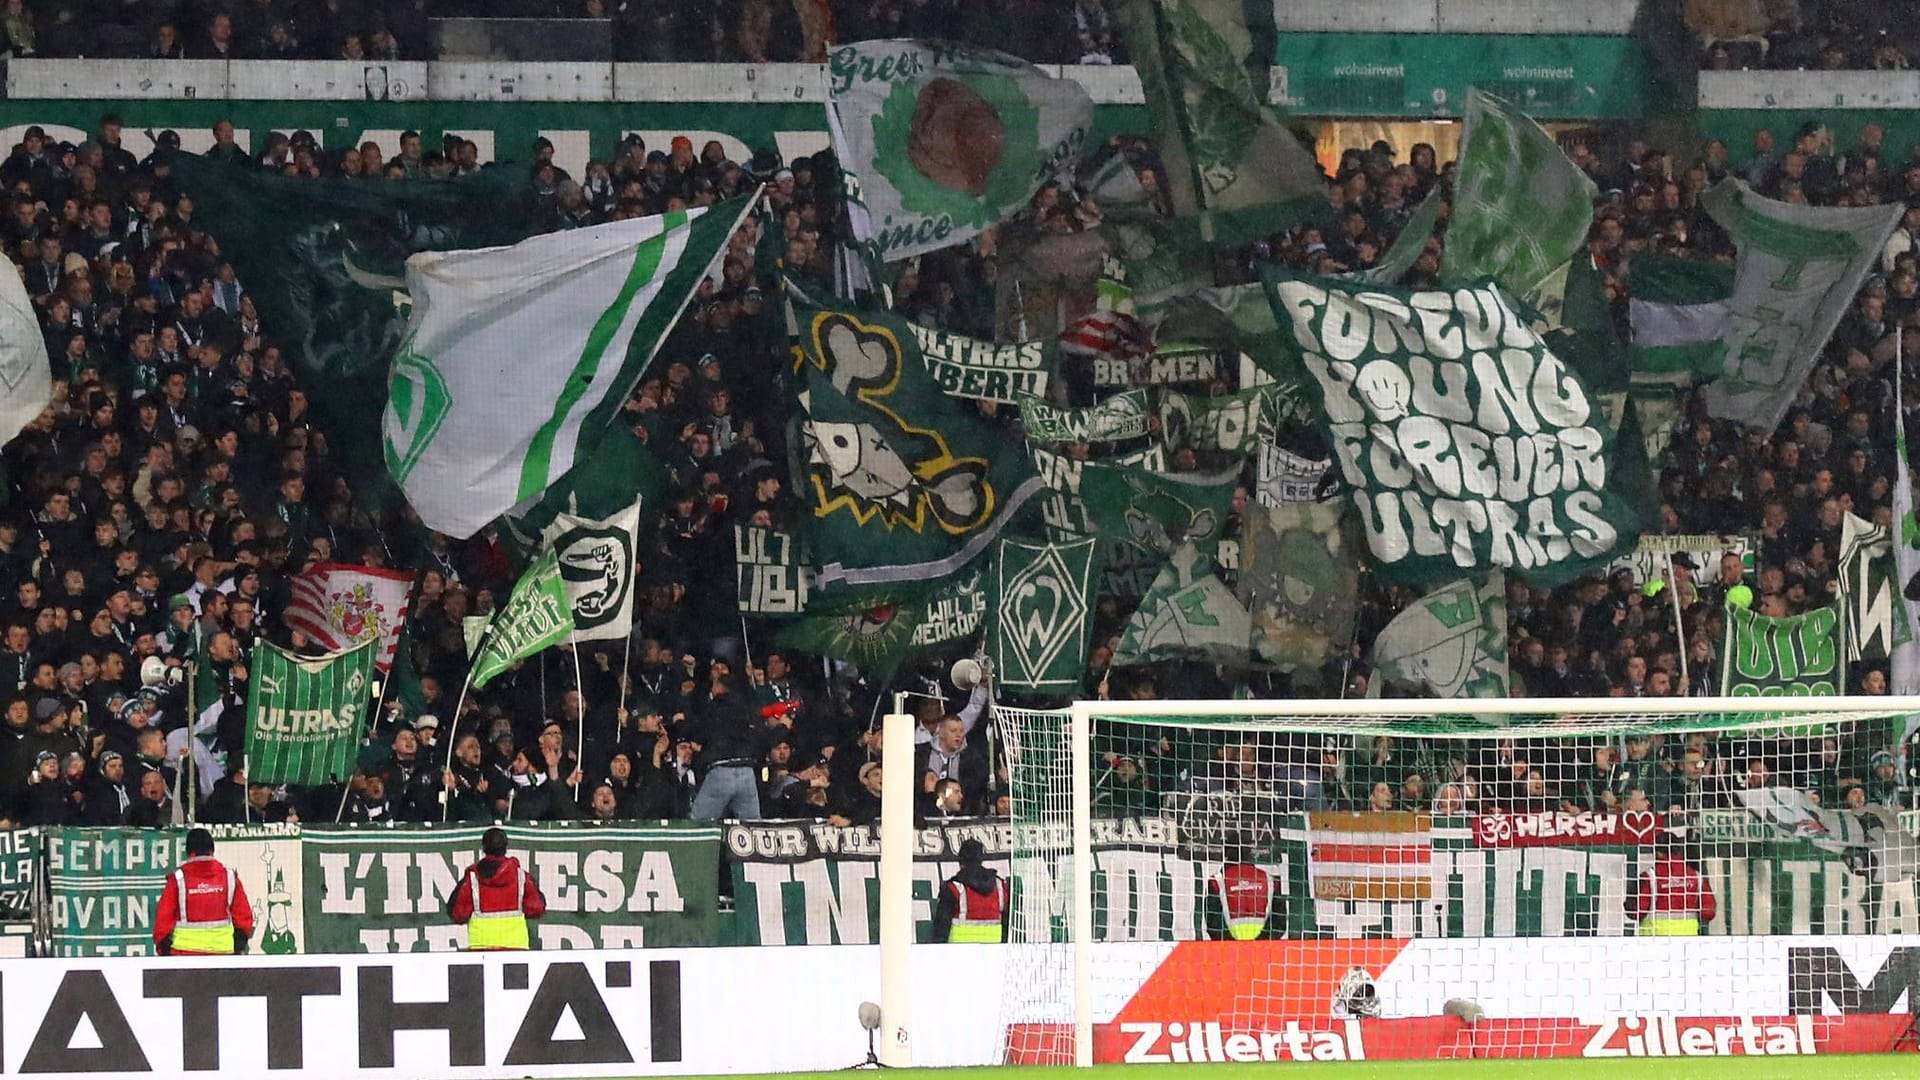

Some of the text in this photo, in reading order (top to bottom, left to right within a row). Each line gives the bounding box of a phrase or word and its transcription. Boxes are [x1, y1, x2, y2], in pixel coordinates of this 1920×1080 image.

[1503, 65, 1575, 80] wohninvest
[1094, 353, 1217, 385] BRMEN
[1330, 416, 1606, 501] FOREVER
[1353, 489, 1618, 570] ULTRAS
[1733, 606, 1837, 681] UTB
[257, 703, 357, 735] ULTRAS
[729, 825, 807, 856] OUR
[319, 850, 684, 915] L'INESA
[0, 960, 681, 1075] ATTHÄI
[1583, 1013, 1817, 1058] Zillertal
[1120, 1019, 1366, 1064] Zillertal
